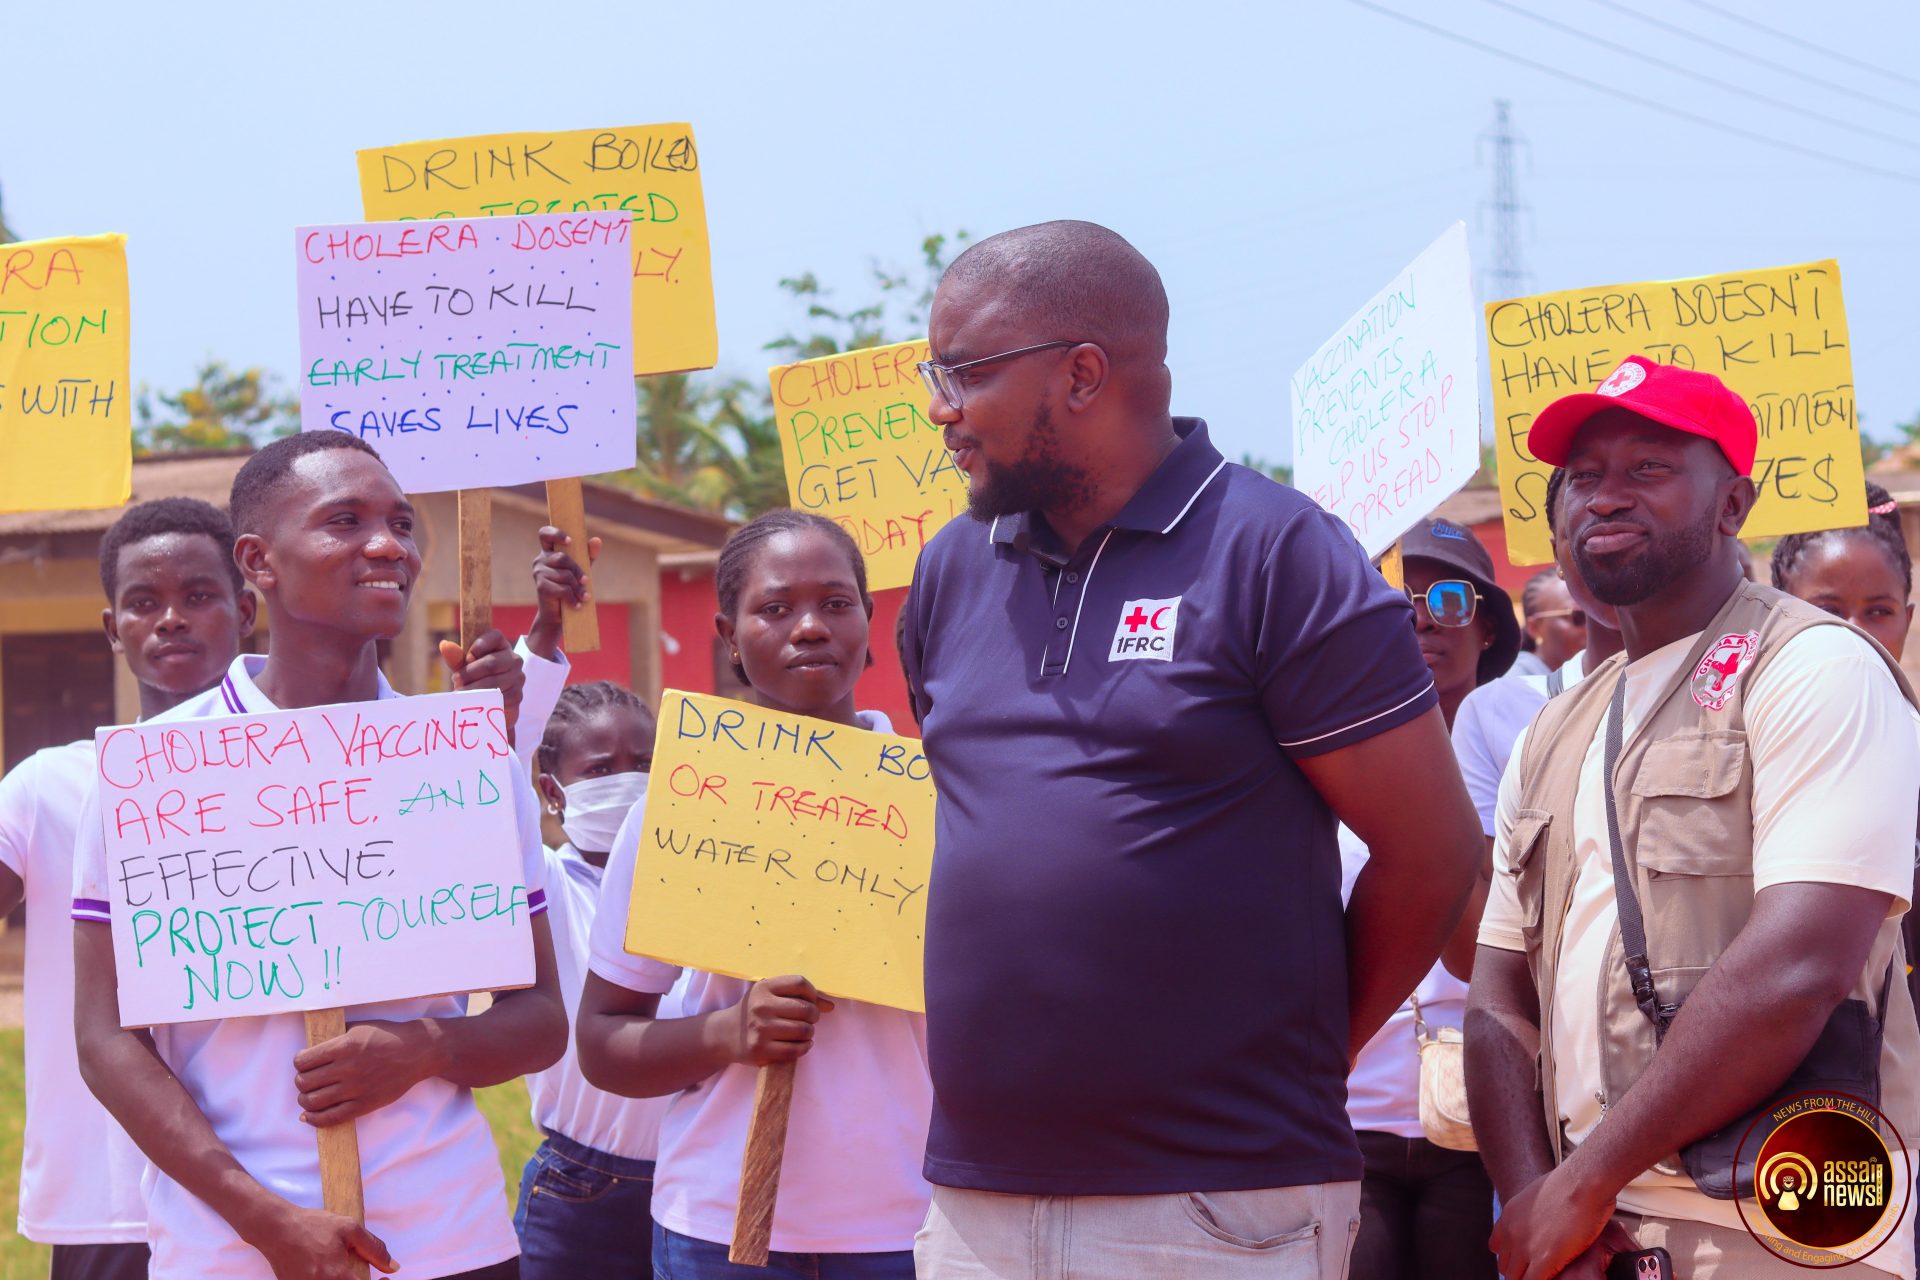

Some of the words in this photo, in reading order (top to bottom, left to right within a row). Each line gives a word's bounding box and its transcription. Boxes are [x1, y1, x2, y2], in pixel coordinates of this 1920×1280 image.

[383, 140, 571, 193] DRINK
[1, 249, 84, 294] RA
[305, 224, 478, 263] CHOLERA
[0, 309, 107, 348] TION
[317, 291, 413, 328] HAVE
[426, 286, 474, 315] TO
[489, 284, 595, 312] KILL
[1292, 273, 1416, 407] VACCINATION
[1490, 293, 1652, 347] CHOLERA
[1672, 269, 1827, 327] DOESN'T
[308, 350, 421, 386] EARLY
[434, 343, 620, 380] TREATMENT
[1298, 336, 1404, 456] PREVENTS
[1501, 349, 1612, 398] HAVE
[1716, 329, 1845, 371] KILL
[22, 380, 114, 417] WITH
[330, 408, 441, 438] SAVES
[467, 405, 578, 434] LIVES
[1329, 349, 1438, 465] CHOLERA
[791, 403, 939, 465] PREVEN
[1309, 460, 1354, 510] ELP
[1362, 438, 1388, 484] US
[1398, 374, 1453, 449] STOP
[798, 459, 878, 508] GET
[896, 449, 966, 488] VA
[1349, 447, 1441, 540] SPREAD
[1117, 636, 1165, 653] IFRC
[100, 720, 310, 789] CHOLERA
[322, 707, 509, 767] VACCINES
[678, 697, 843, 771] DRINK
[877, 744, 931, 780] BO
[115, 789, 226, 845] ARE
[399, 770, 500, 815] AND
[669, 764, 728, 805] OR
[752, 781, 908, 839] TREATED
[655, 827, 799, 880] WATER
[815, 860, 924, 916] ONLY
[131, 901, 323, 967] PROTECT
[338, 883, 529, 941] YOURSELF
[183, 953, 305, 1010] NOW
